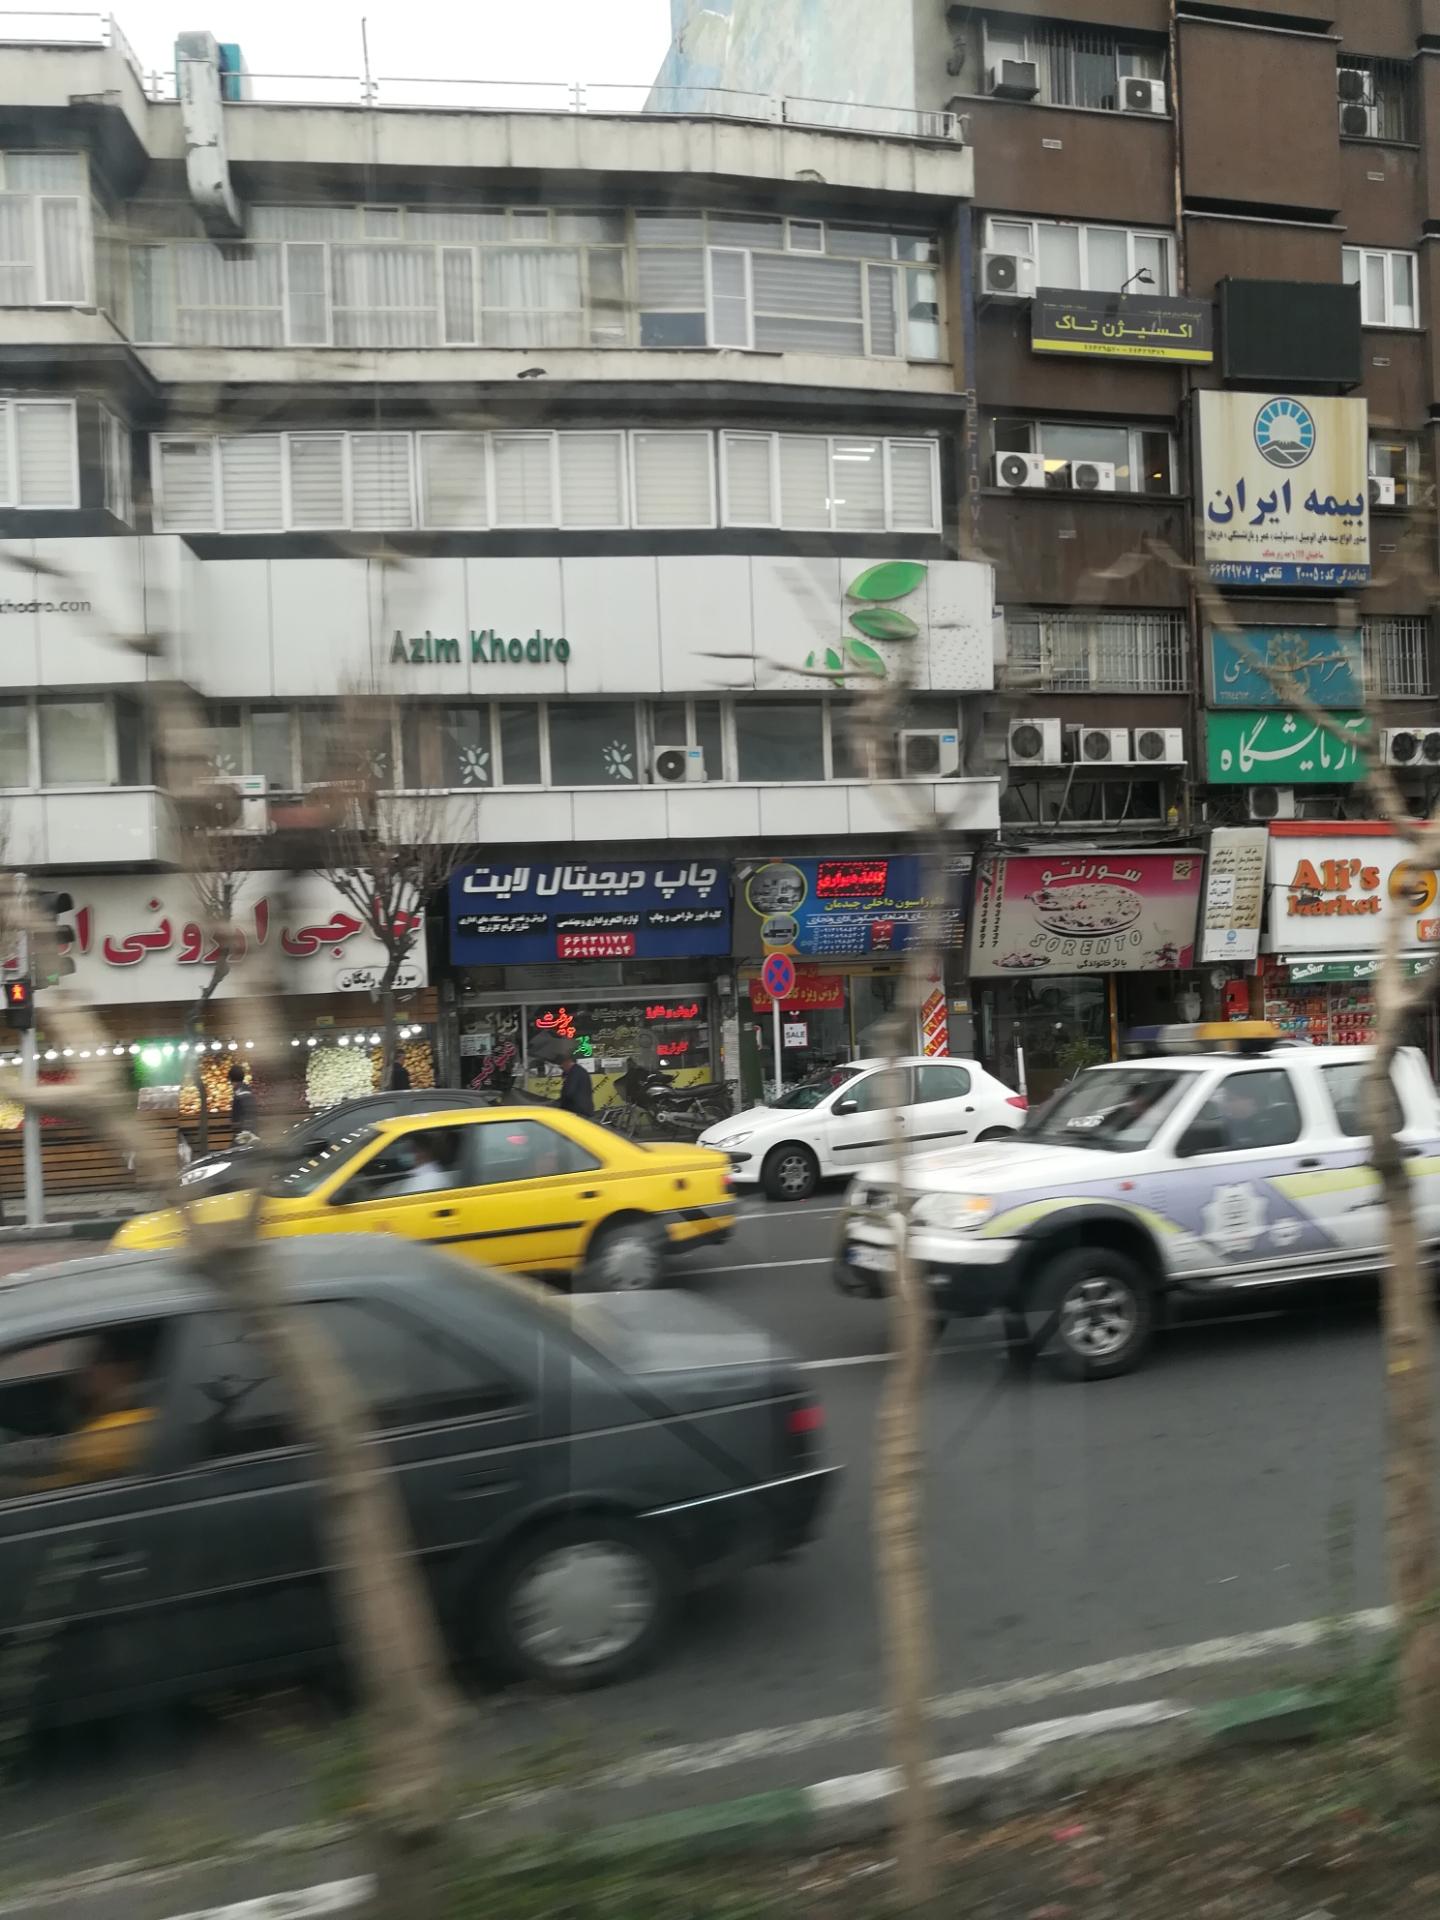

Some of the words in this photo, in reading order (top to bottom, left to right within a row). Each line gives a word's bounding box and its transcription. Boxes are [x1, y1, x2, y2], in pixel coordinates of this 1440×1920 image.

[1056, 314, 1098, 332] تاک
[1102, 319, 1193, 339] اکسیژن
[1208, 476, 1292, 526] ایران
[1304, 488, 1364, 527] بیمه
[1336, 567, 1367, 585] نمایندگی
[389, 629, 462, 664] Azim
[470, 628, 571, 664] Khodro
[1220, 713, 1366, 773] آزمایشگاه
[463, 867, 530, 899] لایت
[536, 865, 646, 897] دیجیتال
[654, 861, 718, 899] چاپ
[1041, 860, 1143, 886] سورنتو
[863, 898, 894, 910] داخلی
[528, 914, 548, 923] فروش
[648, 913, 664, 924] چاپ
[670, 911, 694, 922] طراحی
[709, 910, 723, 920] کلیه
[1029, 929, 1143, 956] SORENTO
[1077, 959, 1111, 970] خانوادگی
[341, 969, 376, 989] رایگان
[818, 983, 840, 1001] فروش
[535, 1007, 577, 1039] پرینت
[785, 1030, 806, 1039] SALE
